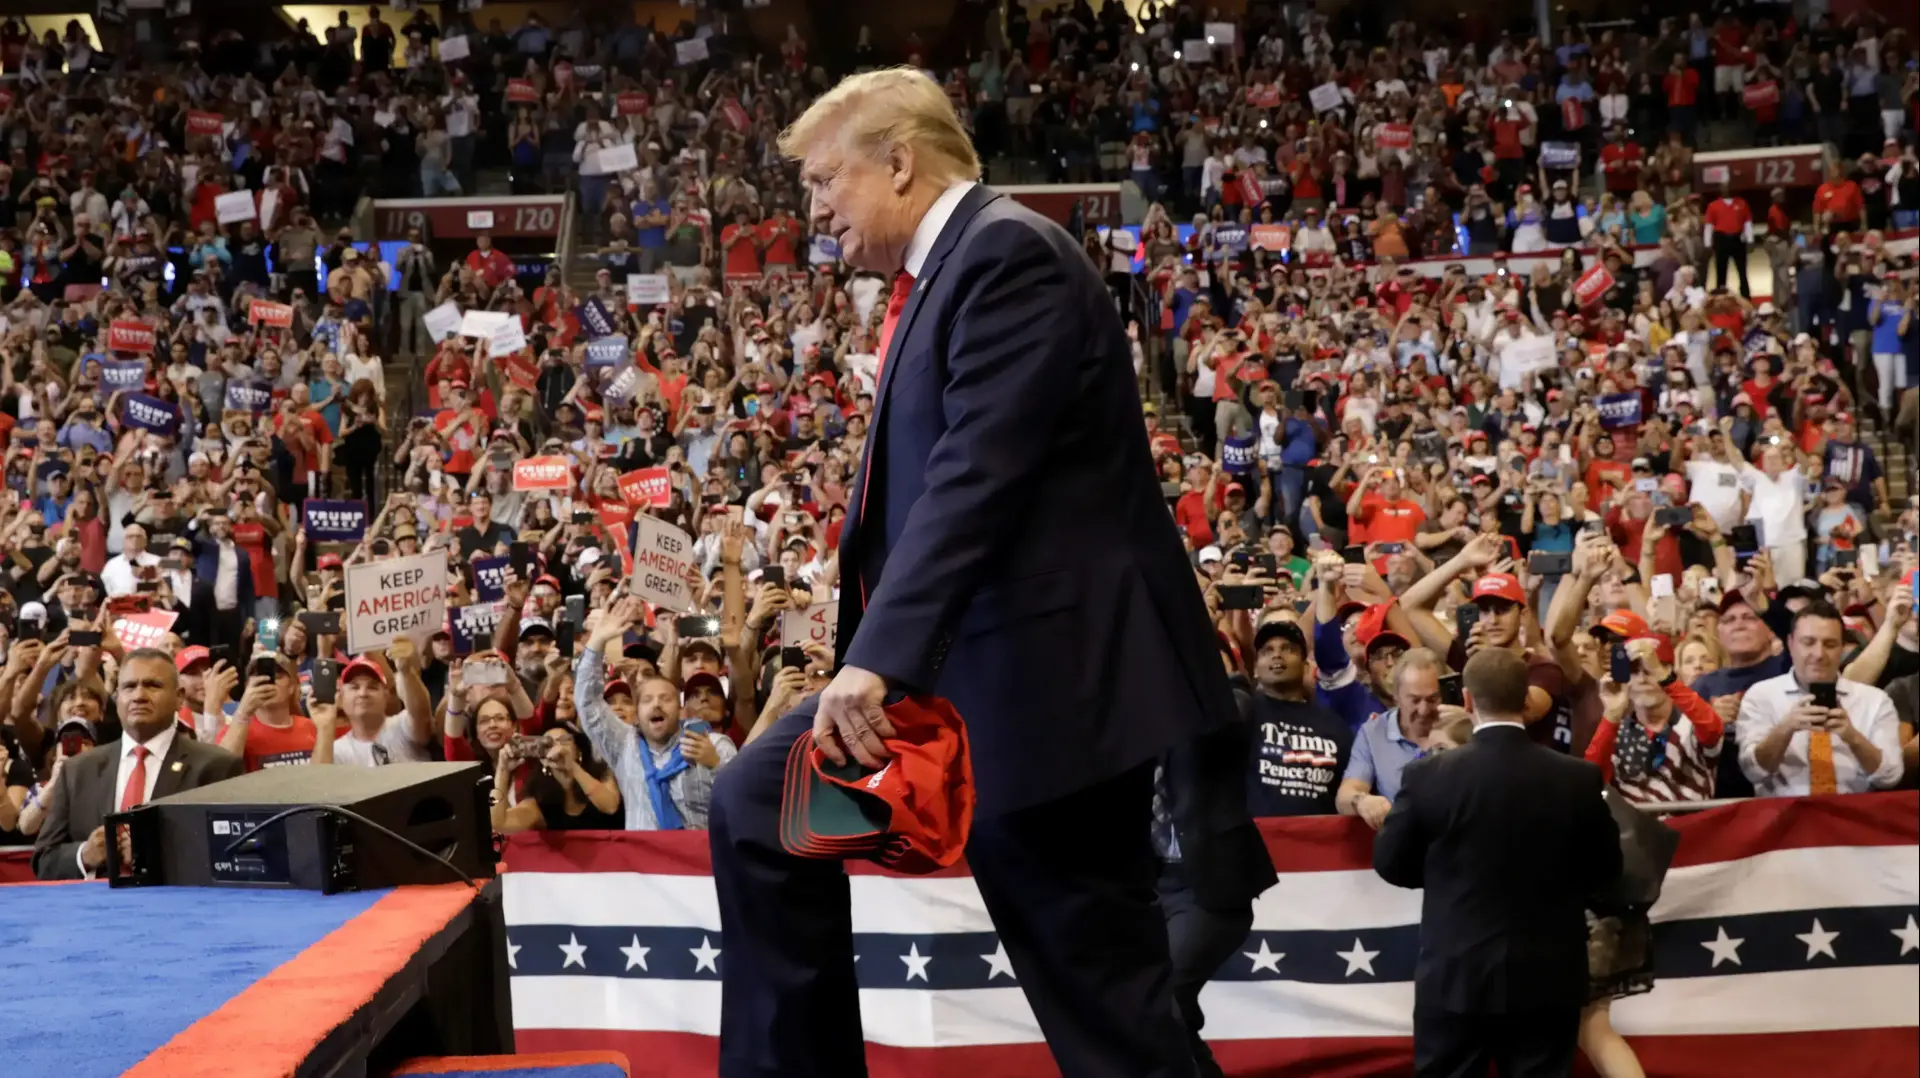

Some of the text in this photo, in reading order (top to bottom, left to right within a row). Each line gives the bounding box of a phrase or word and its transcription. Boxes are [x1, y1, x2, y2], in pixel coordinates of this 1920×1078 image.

[1755, 161, 1795, 184] 122
[1085, 195, 1110, 218] 21
[387, 211, 424, 234] 119
[515, 208, 555, 231] 120
[129, 399, 173, 420] TRUMP
[518, 464, 565, 474] TRUMP
[624, 477, 668, 493] TRUMP
[307, 510, 364, 521] TRUMP
[656, 532, 683, 555] KEEP
[639, 548, 688, 579] AMERIC
[380, 568, 424, 590] KEEP
[356, 583, 442, 618] AMERICA
[373, 608, 431, 635] GREAT!
[454, 616, 502, 631] TRUM
[1260, 722, 1338, 758] Trump
[1258, 759, 1305, 780] Pence
